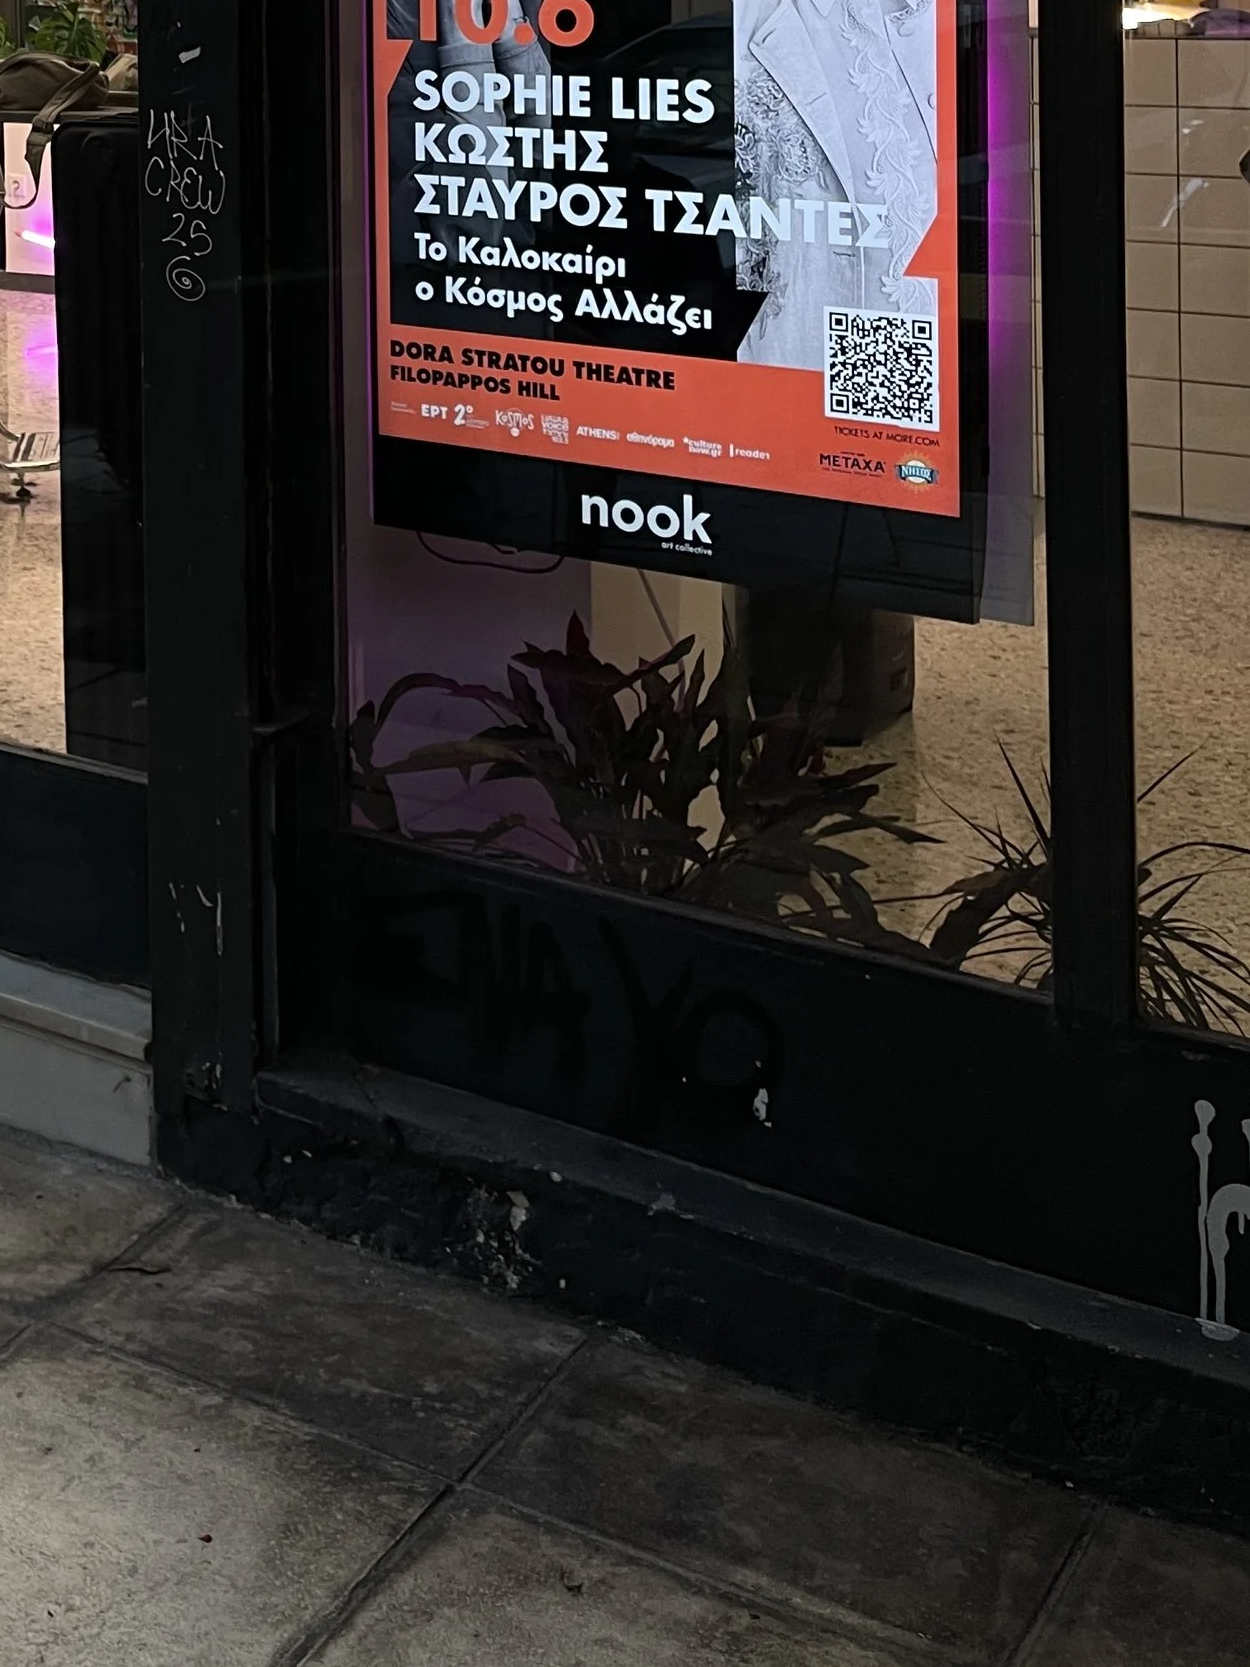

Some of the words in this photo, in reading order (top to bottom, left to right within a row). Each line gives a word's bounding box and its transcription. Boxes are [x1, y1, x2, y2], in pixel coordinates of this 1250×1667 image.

[412, 69, 592, 118] SOPHIE
[611, 76, 716, 124] LIES
[414, 121, 610, 174] ΚΩΣΤΗΣ
[413, 173, 629, 230] ΣΤΑΥΡΟΣ
[643, 188, 890, 249] ΤΣΑΝΤΕΣ
[413, 231, 447, 262] Το
[458, 236, 627, 285] Καλοκαίρι
[414, 281, 435, 303] ο
[444, 275, 565, 323] Κόσμος
[574, 287, 713, 335] Αλλάζει
[389, 339, 455, 365] DORA
[461, 347, 566, 378] STRATOU
[572, 360, 676, 391] THEATRE
[389, 364, 512, 395] FILOPAPPOS
[517, 380, 561, 401] HILL
[576, 425, 617, 440] ATHENS
[834, 426, 870, 439] TICKETS
[872, 431, 883, 440] AT
[819, 453, 886, 474] METAXA
[581, 493, 713, 545] nook
[661, 541, 674, 550] art
[675, 542, 713, 557] collective
